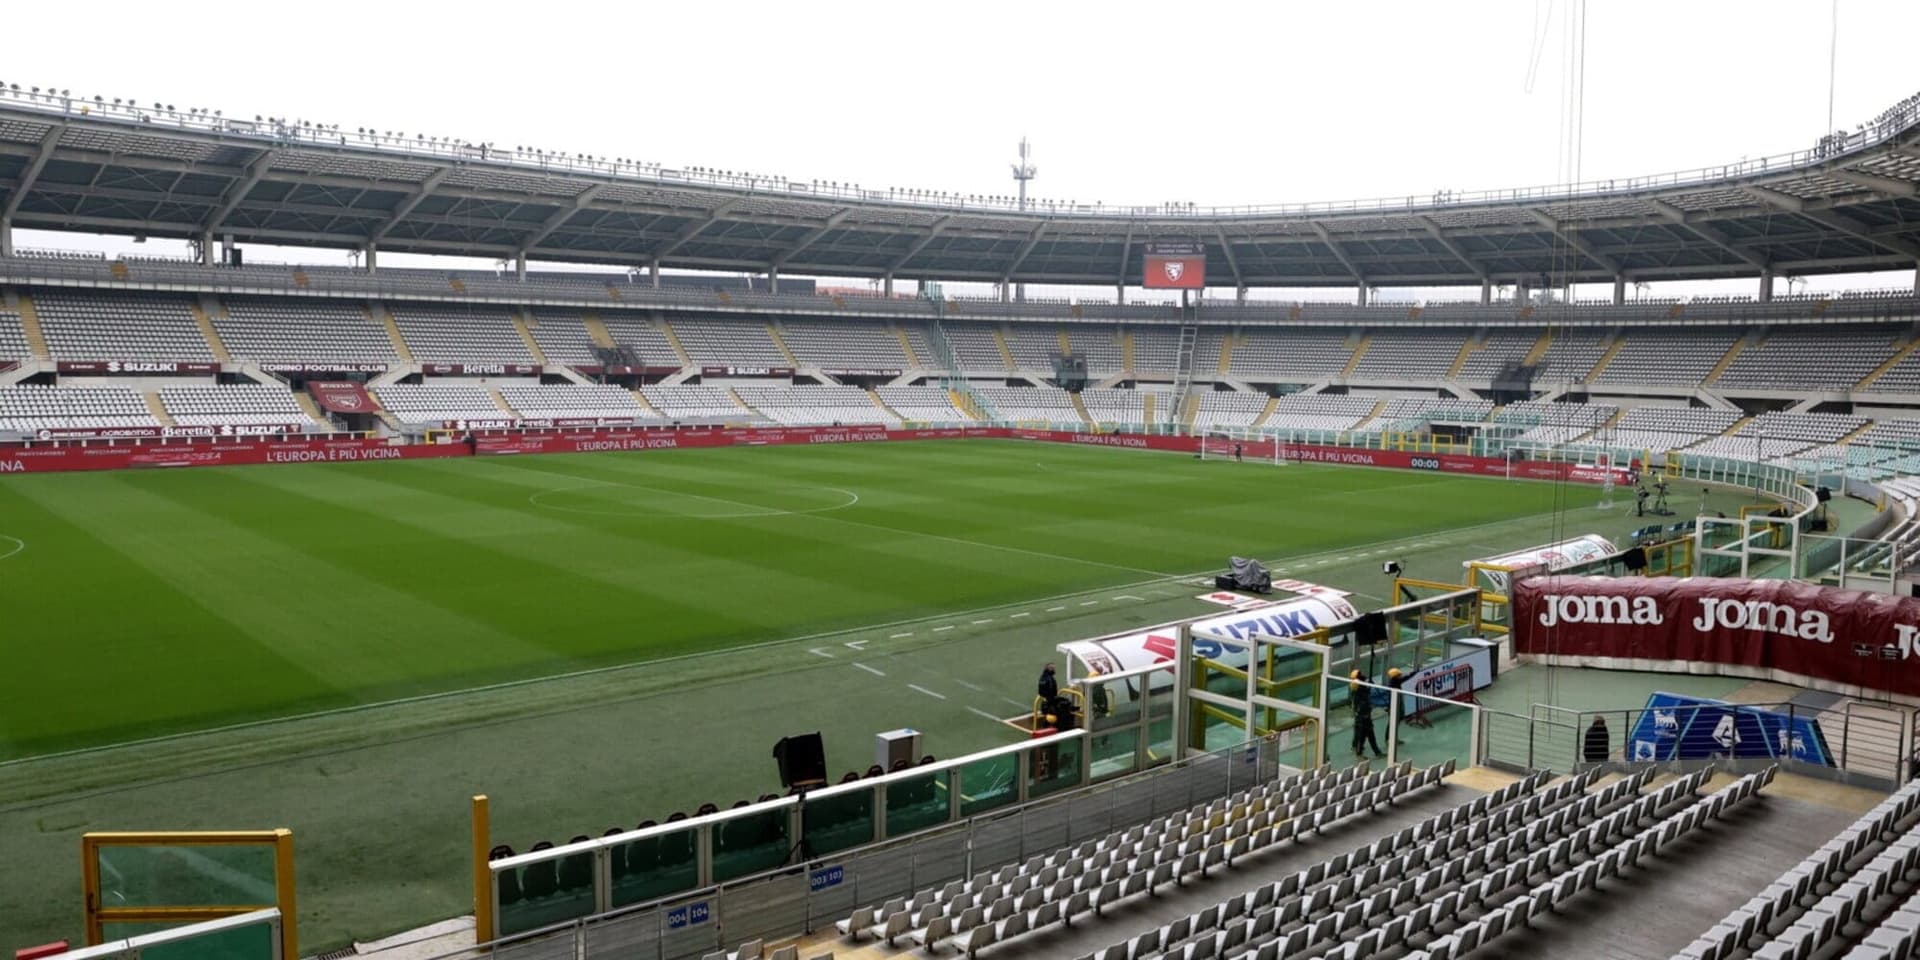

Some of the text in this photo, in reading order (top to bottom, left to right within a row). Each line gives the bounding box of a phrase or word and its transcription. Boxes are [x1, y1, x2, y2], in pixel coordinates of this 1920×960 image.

[123, 362, 178, 372] SUZUKI
[262, 364, 387, 372] TORINO FOOTBALL CLUB
[463, 364, 505, 374] Beretta
[736, 367, 770, 375] SUZUKI
[236, 425, 287, 436] SUZUKI
[469, 420, 511, 429] SUZUKI
[165, 426, 212, 437] Beretta
[576, 441, 621, 452] L'EUROPA
[647, 439, 677, 449] VICINA
[266, 451, 326, 462] L'EUROPA
[361, 447, 401, 459] VICINA
[1343, 453, 1374, 465] VICINA
[1411, 457, 1440, 469] 00:00
[1539, 594, 1664, 628] Joma
[1692, 596, 1835, 644] Joma
[1194, 608, 1320, 660] SUZUKI
[811, 869, 843, 887] 003 103
[669, 907, 708, 925] 004 104
